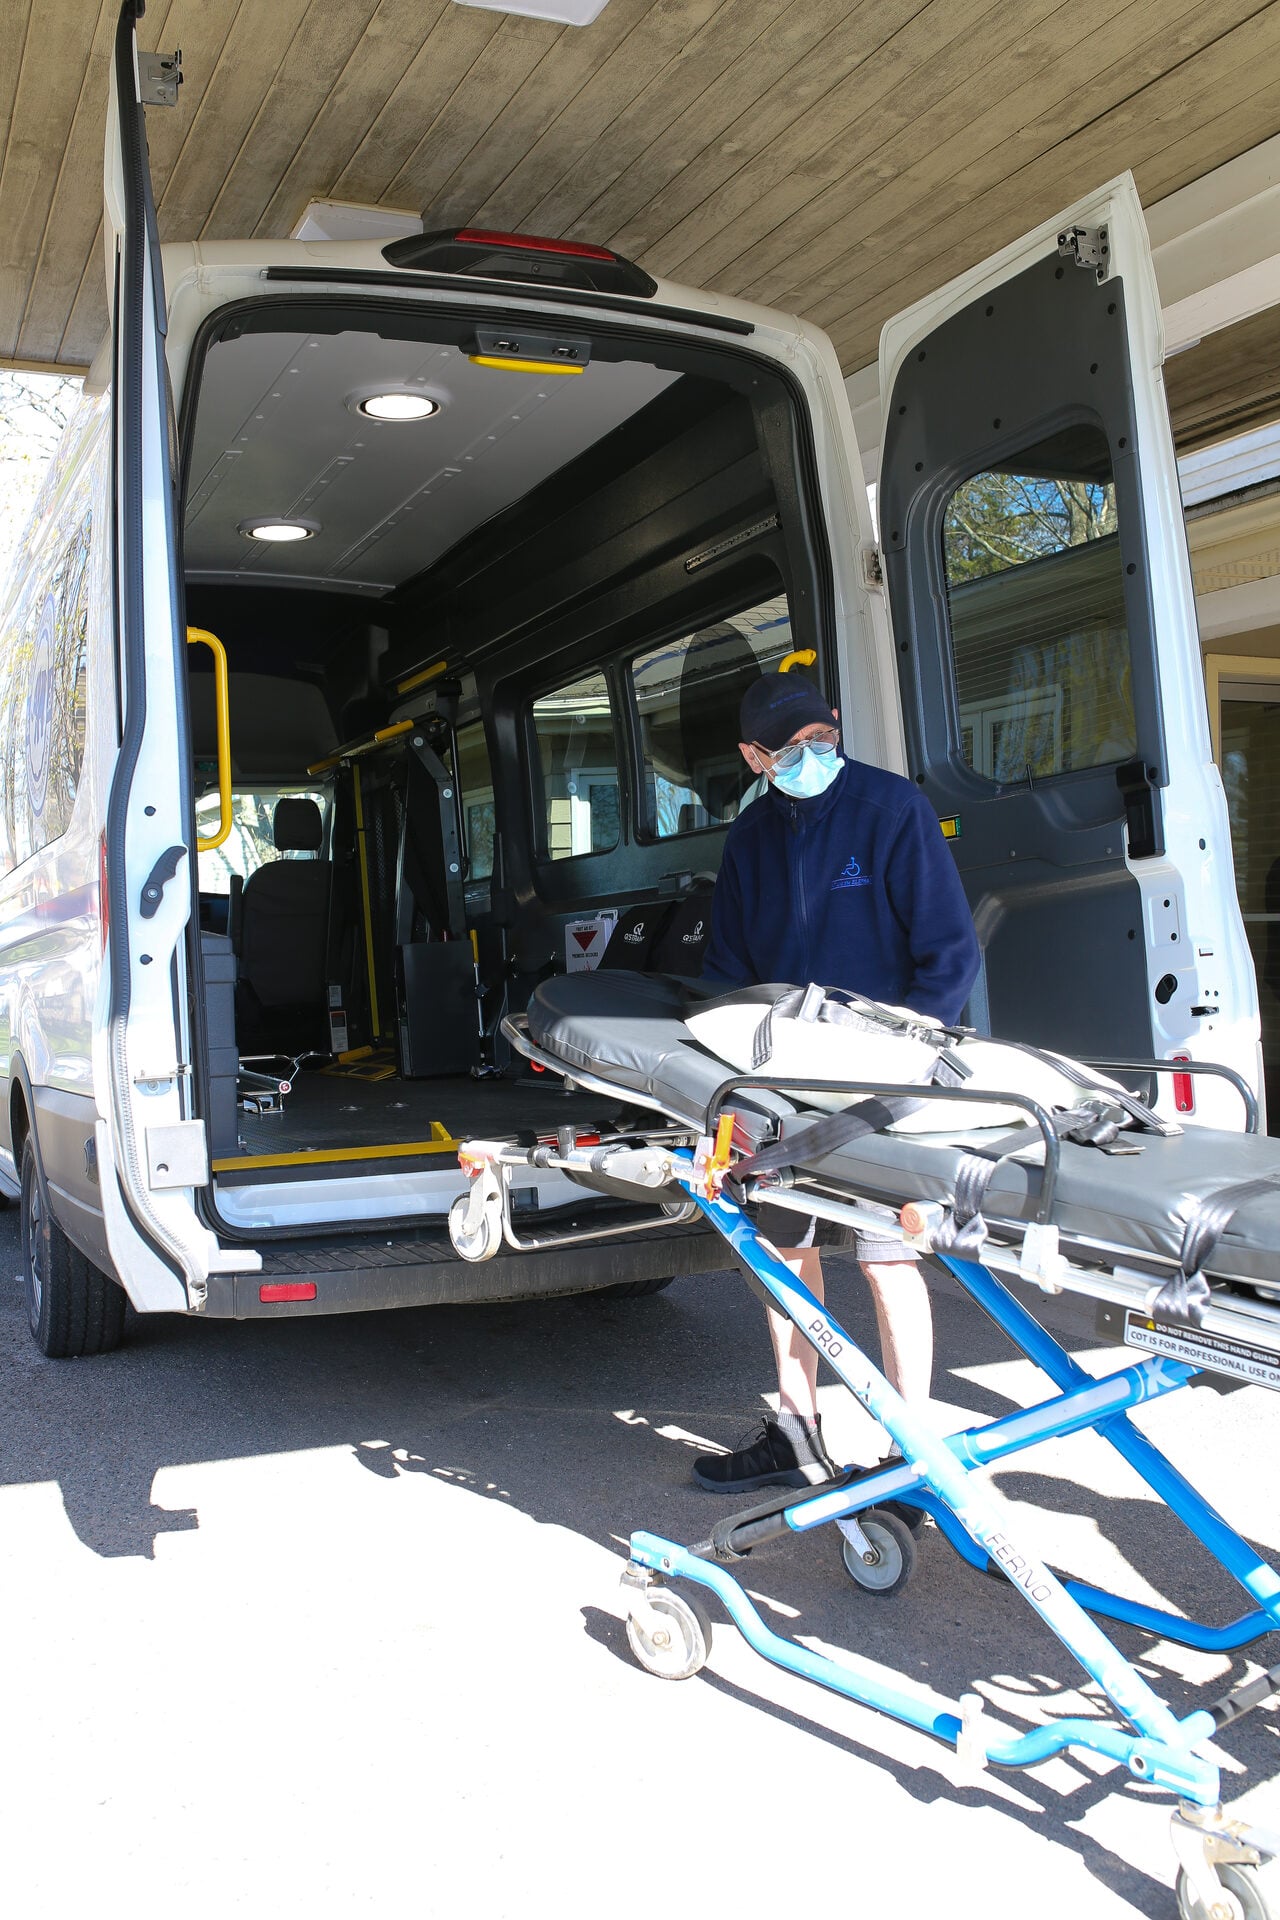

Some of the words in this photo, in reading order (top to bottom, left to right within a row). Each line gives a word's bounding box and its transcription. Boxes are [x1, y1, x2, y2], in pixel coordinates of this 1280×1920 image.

[808, 1319, 843, 1358] PRO
[1130, 1331, 1148, 1343] COT
[1149, 1336, 1157, 1345] IS
[1159, 1340, 1176, 1351] FOR
[1178, 1344, 1246, 1372] PROFESSIONAL
[1248, 1366, 1267, 1378] USE
[1155, 1323, 1168, 1332] DO
[1168, 1326, 1182, 1337] NOT
[1182, 1331, 1212, 1346] REMOVE
[1212, 1340, 1229, 1351] THIS
[1229, 1344, 1252, 1357] HAND
[1252, 1351, 1279, 1365] GUARD
[986, 1533, 1052, 1602] FERNO
